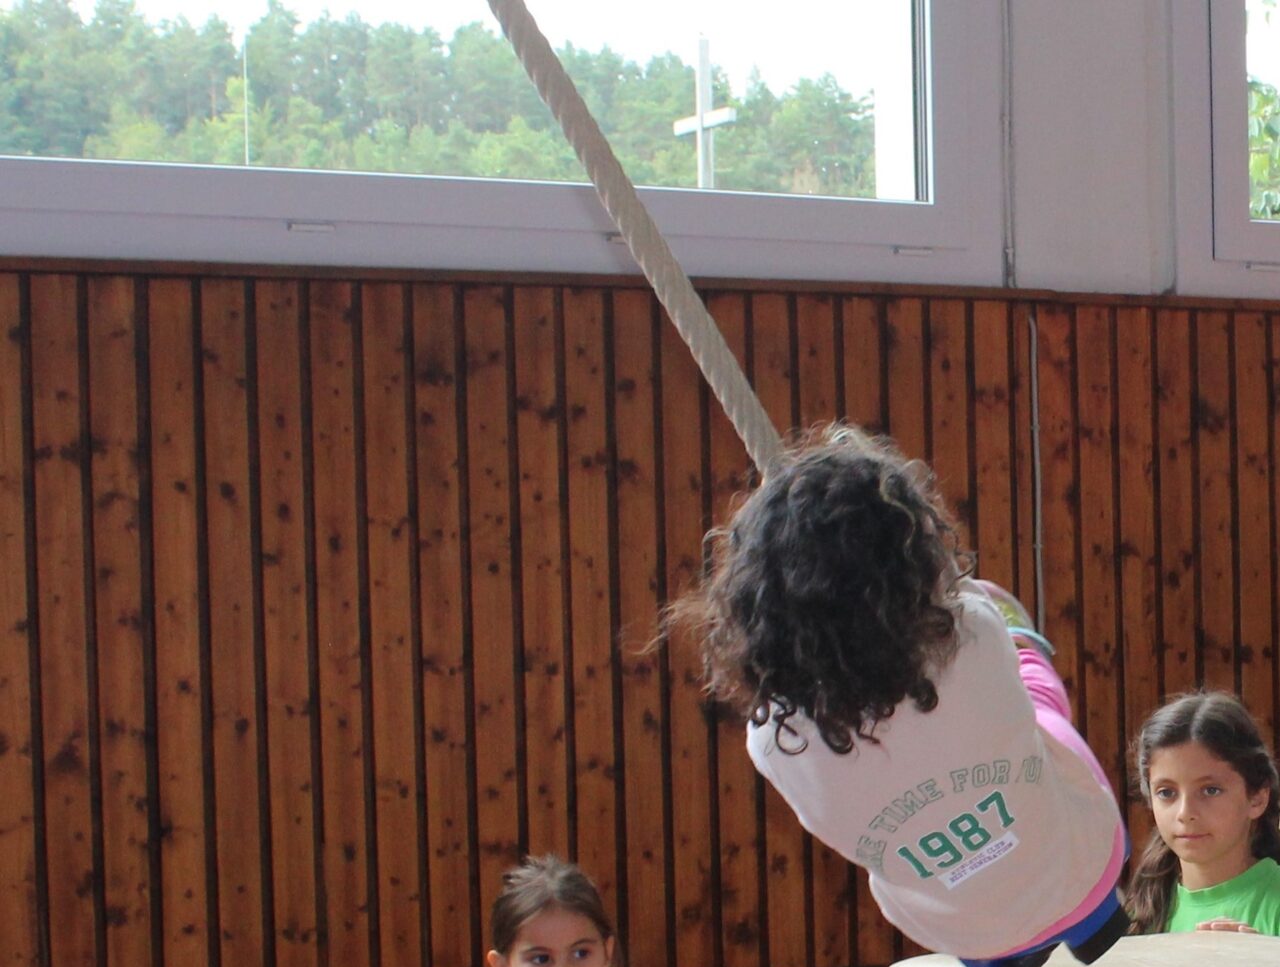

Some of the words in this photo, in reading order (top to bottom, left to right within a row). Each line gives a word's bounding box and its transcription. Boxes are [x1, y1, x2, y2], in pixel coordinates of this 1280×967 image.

[868, 778, 944, 834] TIME
[949, 759, 1011, 794] FOR
[896, 790, 1016, 880] 1987
